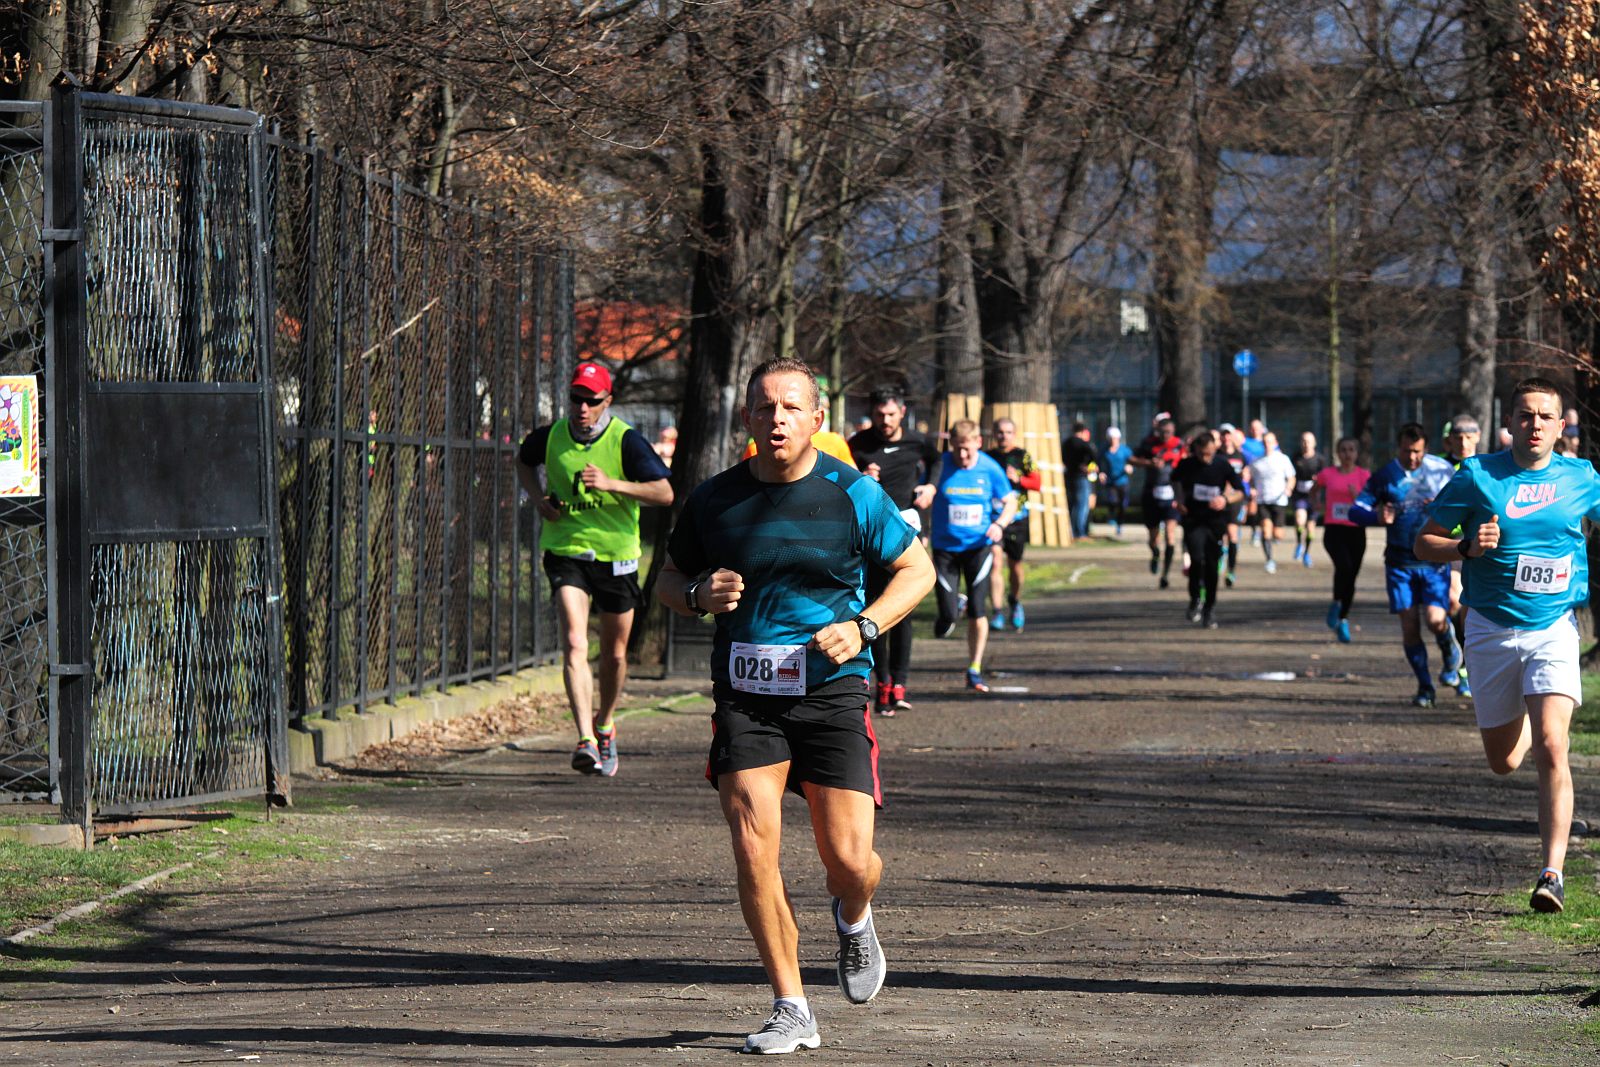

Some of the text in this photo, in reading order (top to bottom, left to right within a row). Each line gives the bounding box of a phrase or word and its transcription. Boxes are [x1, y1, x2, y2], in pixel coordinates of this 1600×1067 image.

[1515, 483, 1557, 503] RUN
[1521, 565, 1554, 584] 033
[734, 655, 773, 682] 028
